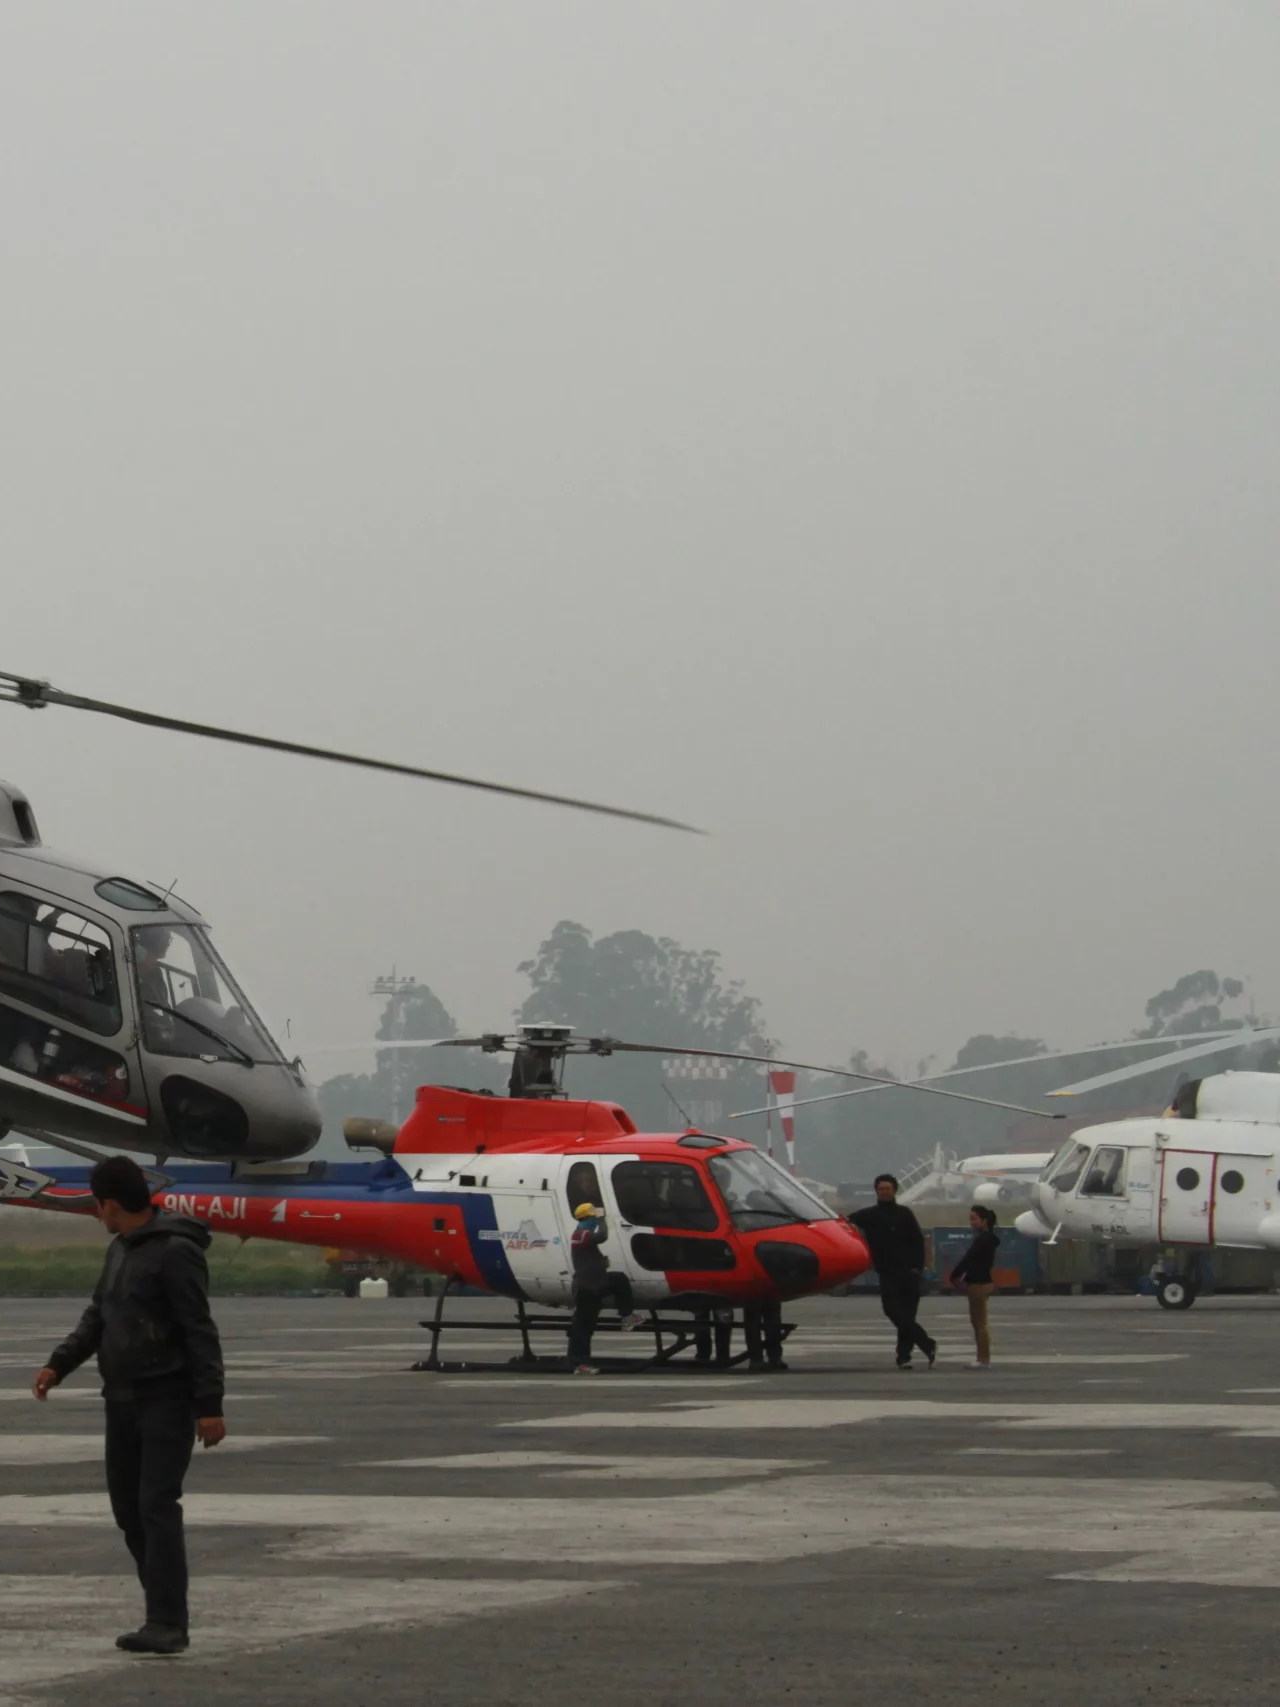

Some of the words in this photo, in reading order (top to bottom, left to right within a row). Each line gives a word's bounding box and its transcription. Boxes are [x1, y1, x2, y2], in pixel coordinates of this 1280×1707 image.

[163, 1193, 247, 1220] 9N-AJI
[479, 1230, 529, 1241] FISHTAIL
[505, 1240, 530, 1250] AIR
